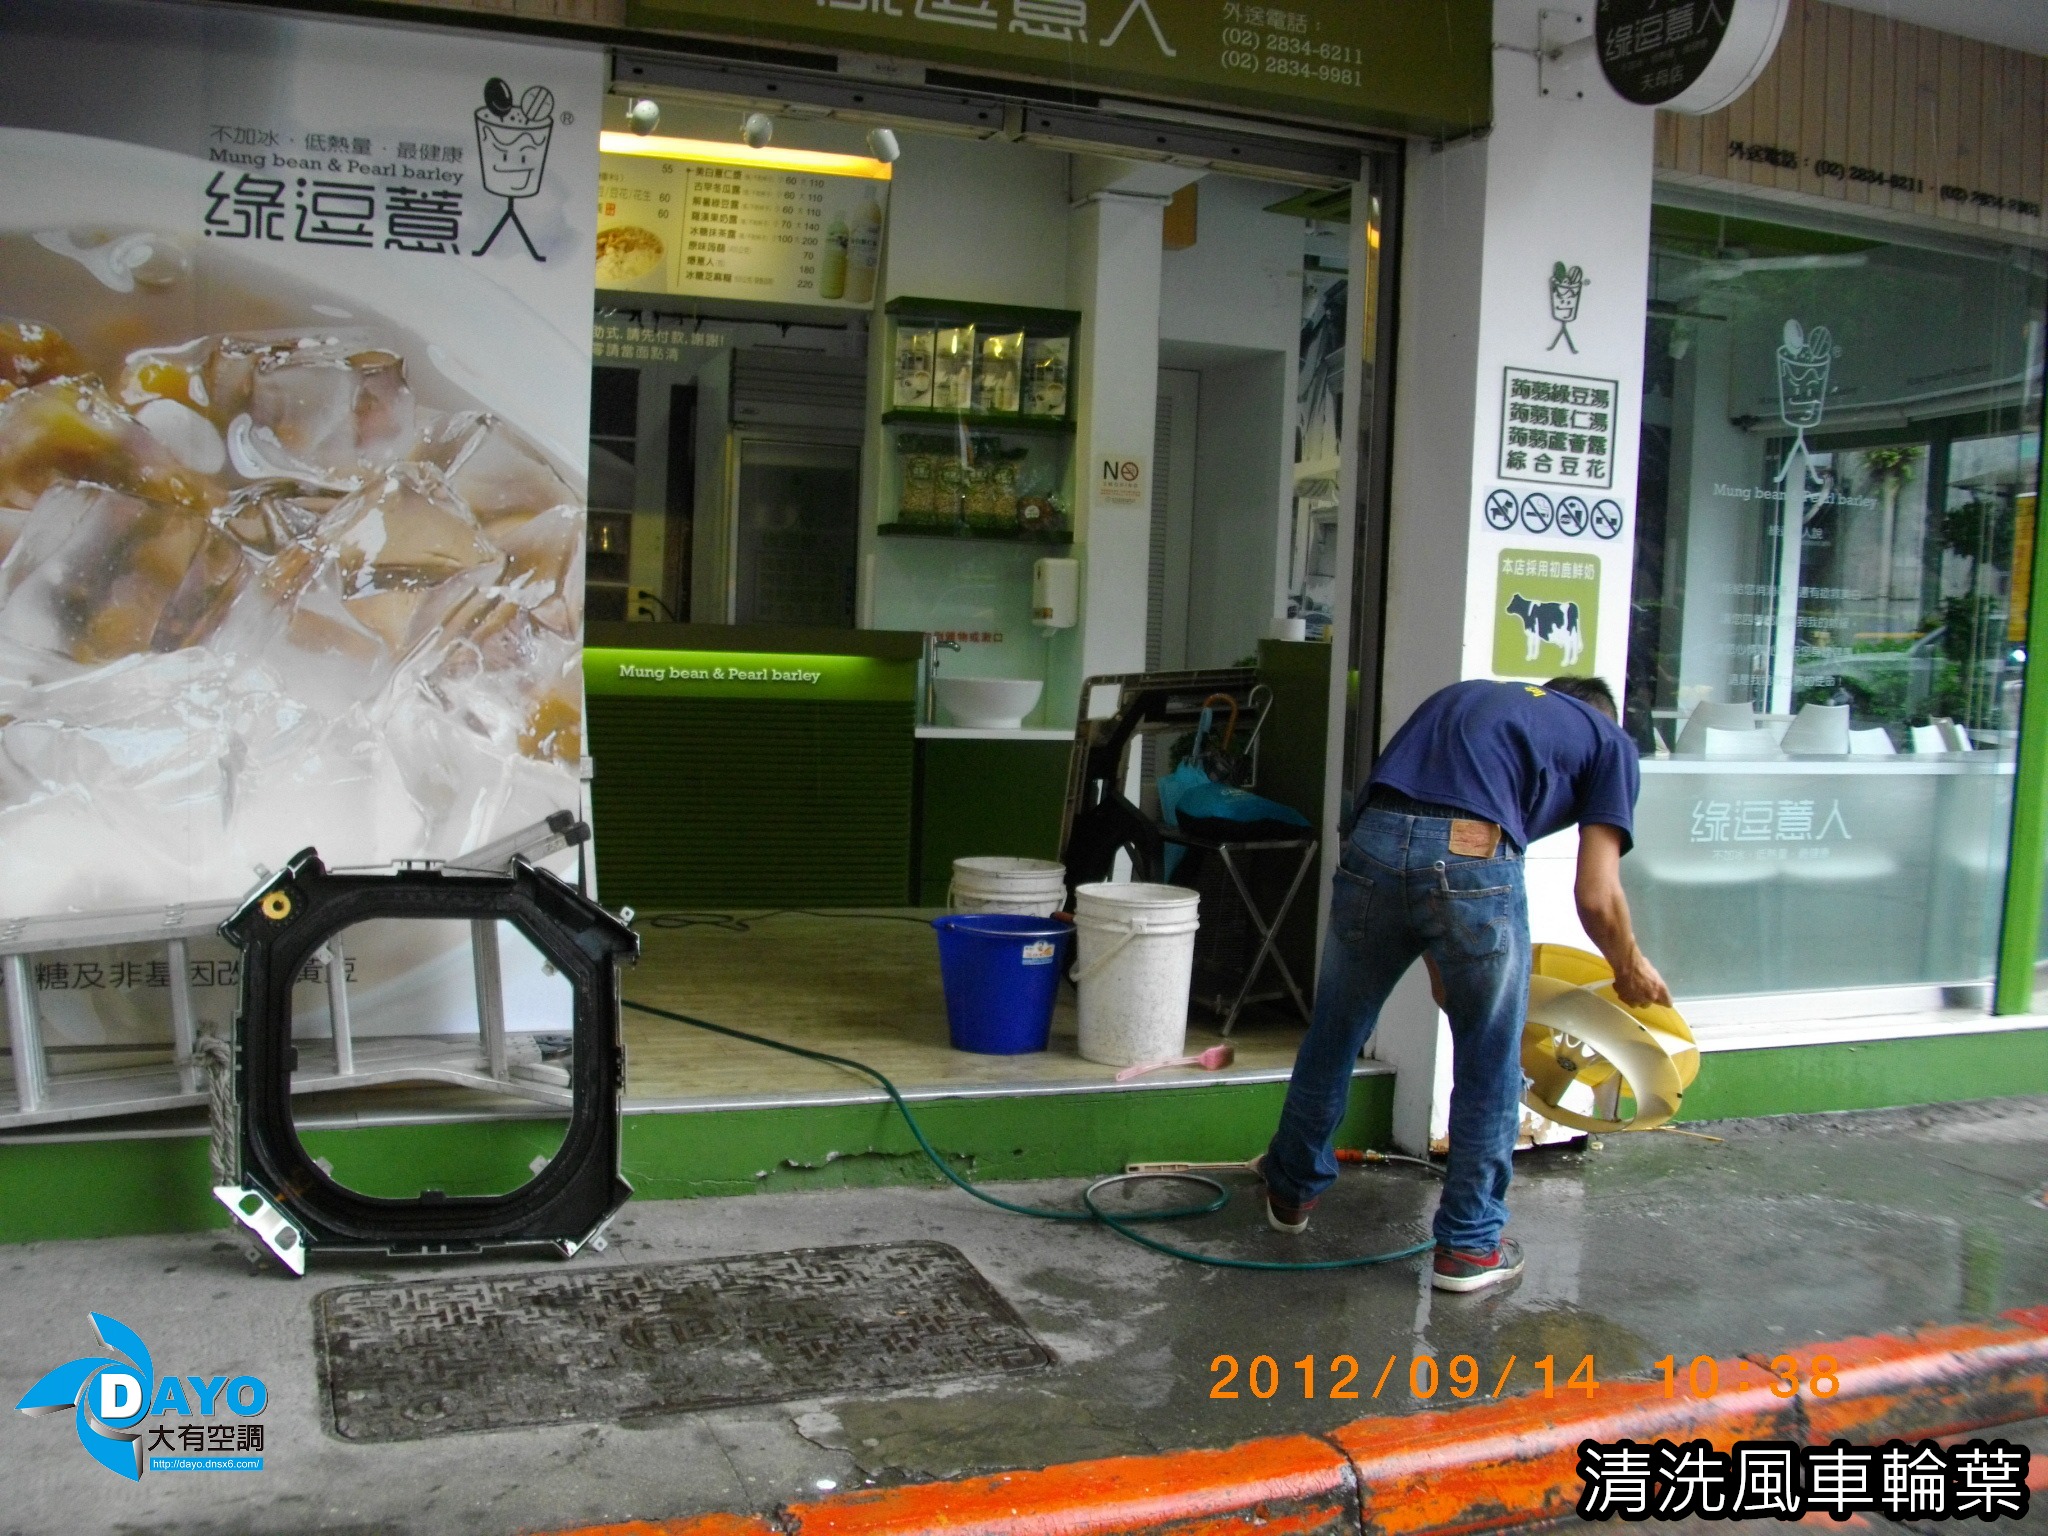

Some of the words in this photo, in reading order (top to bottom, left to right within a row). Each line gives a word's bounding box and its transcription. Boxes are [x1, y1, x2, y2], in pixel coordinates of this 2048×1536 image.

[1222, 27, 1260, 51] (02)
[1266, 34, 1362, 65] 2834-6211
[1221, 50, 1259, 73] (02)
[1265, 56, 1362, 87] 2834-9981
[208, 147, 266, 169] Mung
[272, 153, 322, 171] bean
[328, 157, 342, 172] &
[347, 160, 397, 177] Pearl
[402, 164, 464, 186] barley
[810, 179, 825, 189] 110
[808, 194, 823, 203] 110
[806, 208, 821, 217] 110
[781, 220, 792, 229] 70
[804, 222, 820, 232] 140
[803, 251, 814, 260] 70
[1505, 449, 1606, 479] 綜合豆花
[1713, 483, 1752, 501] Mung
[1837, 493, 1878, 511] barley
[1501, 557, 1596, 580] 本店採用初鹿鮮奶
[619, 664, 665, 681] Mung
[669, 667, 709, 680] bean
[712, 668, 725, 680] &
[728, 669, 768, 681] Pearl
[771, 669, 821, 684] barley
